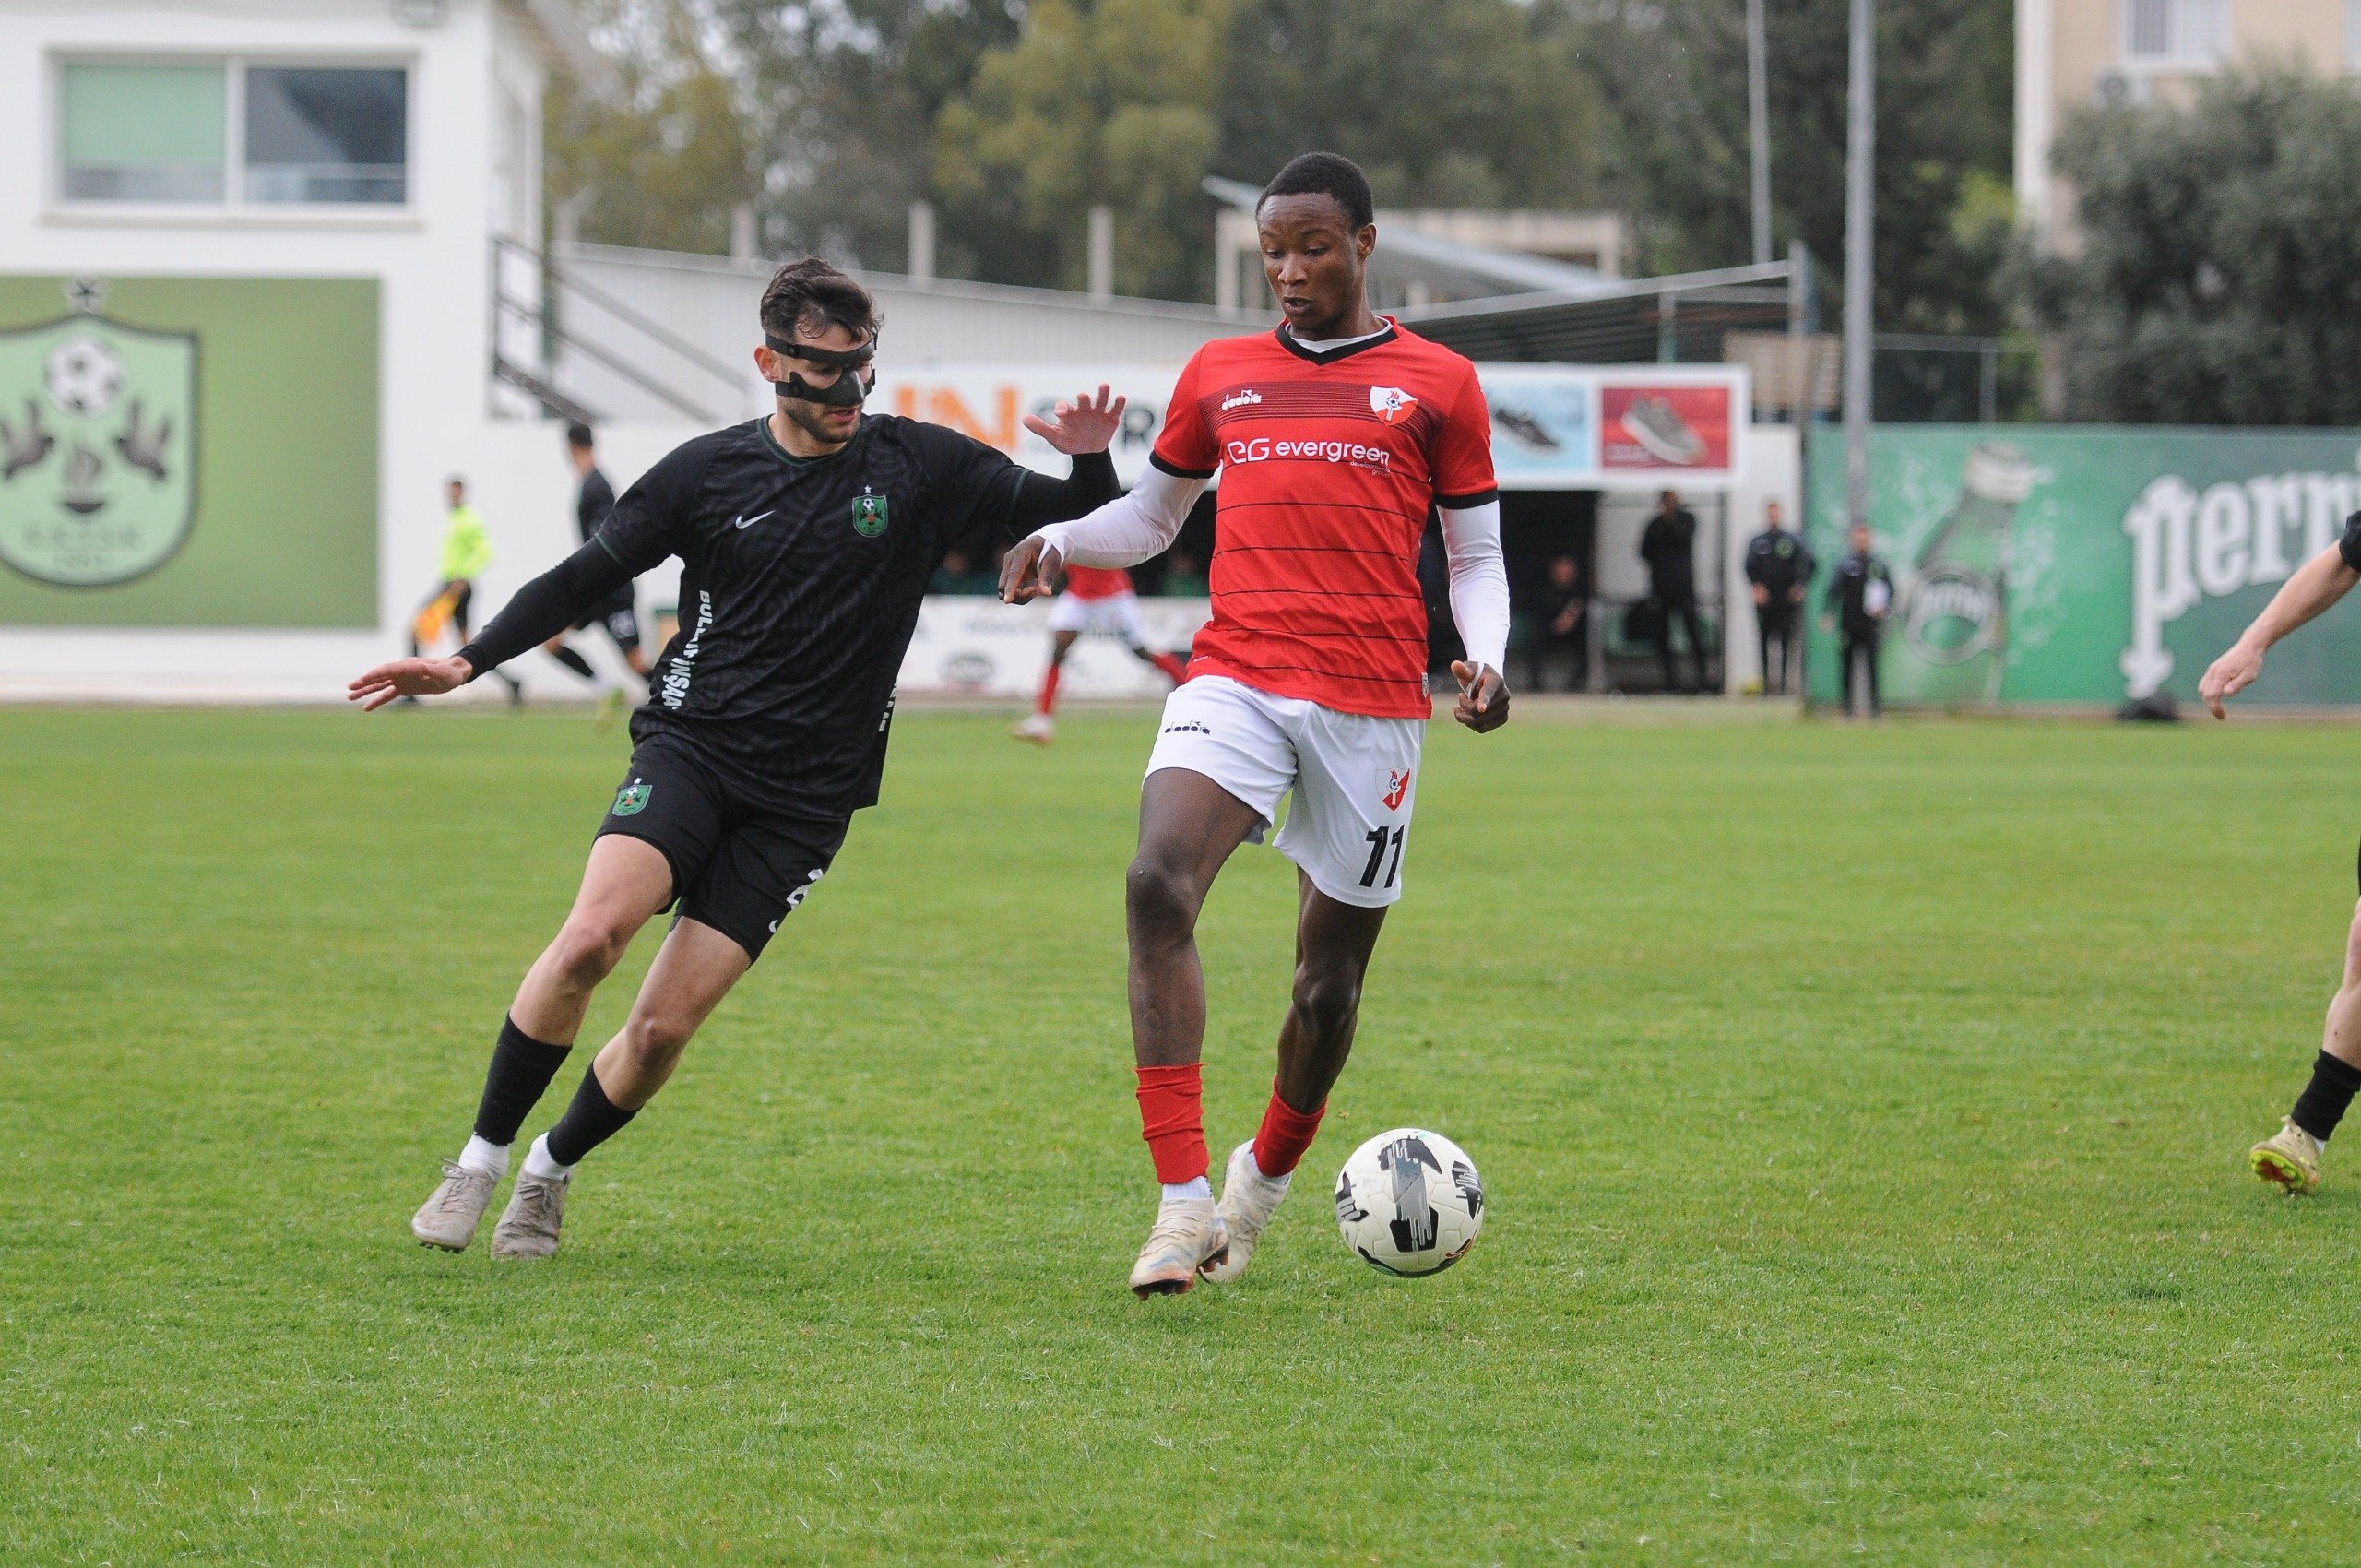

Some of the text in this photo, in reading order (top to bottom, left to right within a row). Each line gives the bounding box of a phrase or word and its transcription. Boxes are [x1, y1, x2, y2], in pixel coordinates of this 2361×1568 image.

[1275, 441, 1390, 466] evergreen
[2121, 454, 2361, 698] perr
[662, 658, 695, 710] İNŞAA
[1358, 825, 1405, 888] 11
